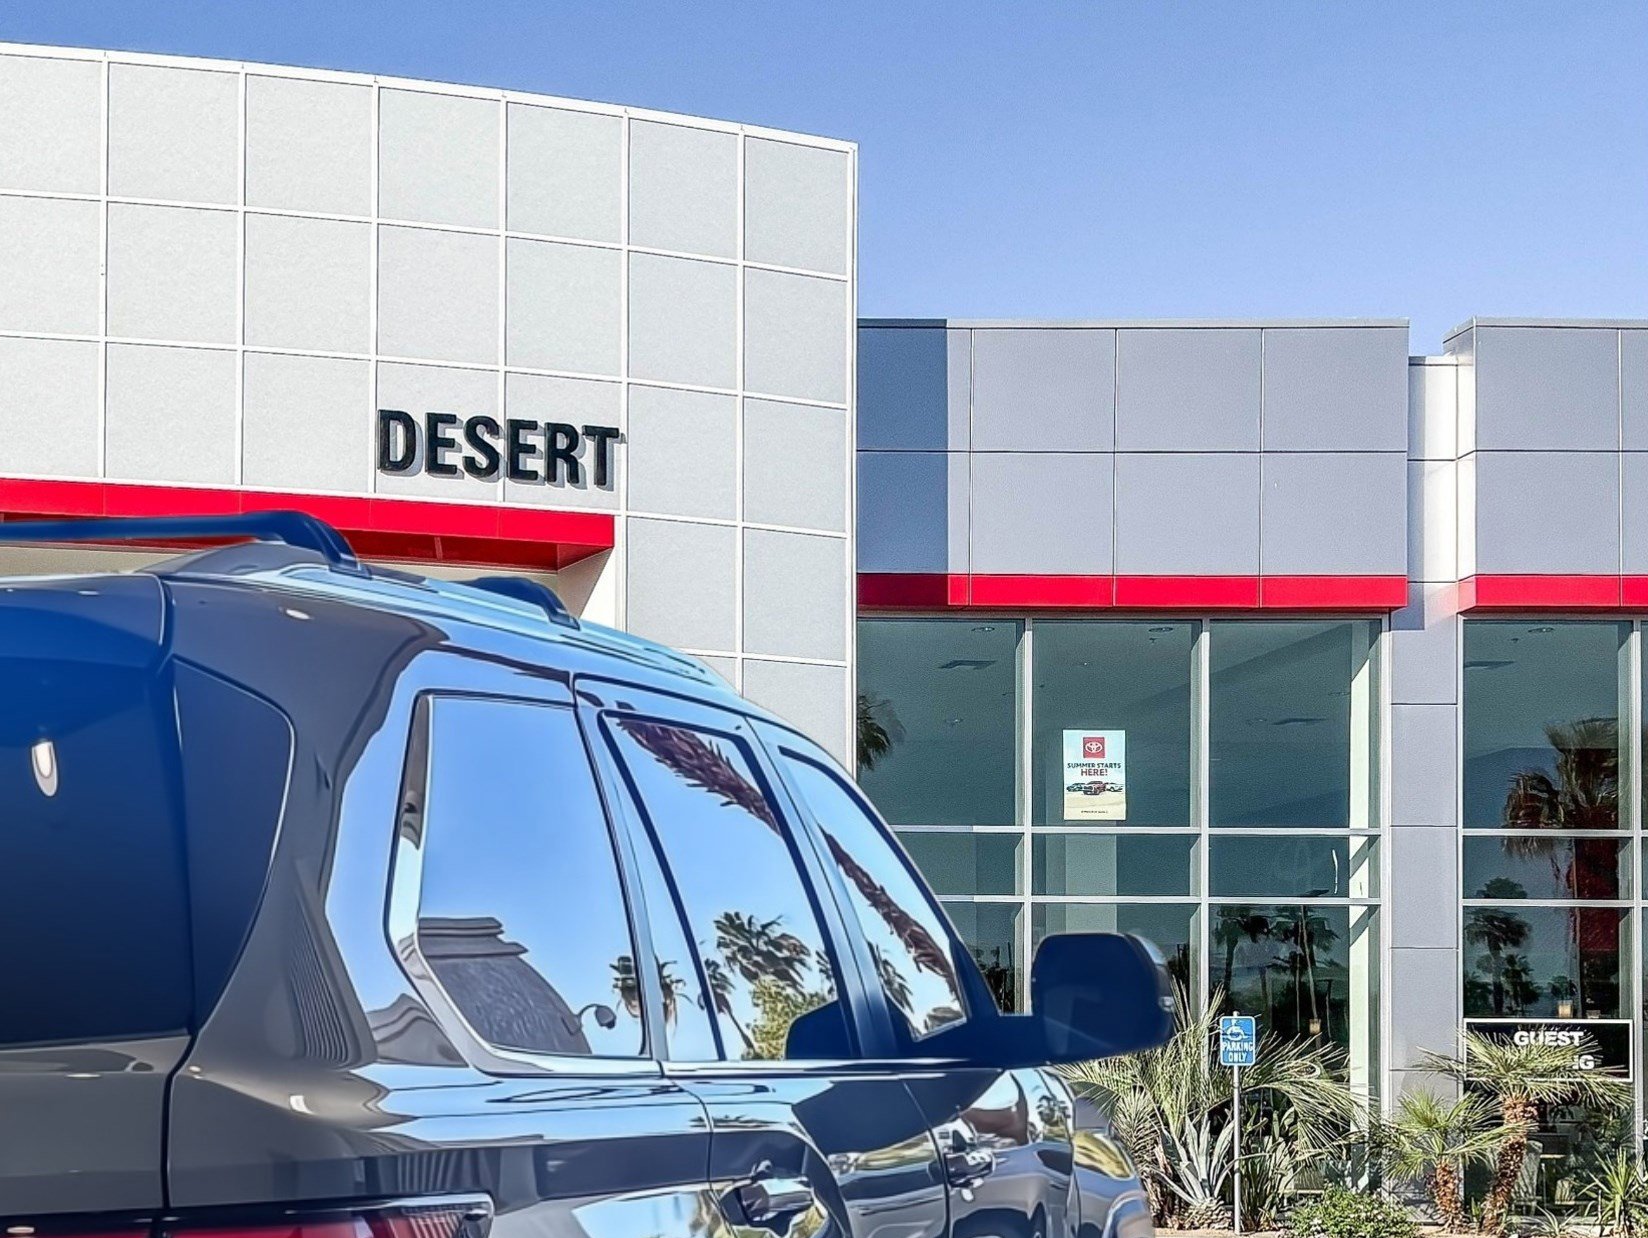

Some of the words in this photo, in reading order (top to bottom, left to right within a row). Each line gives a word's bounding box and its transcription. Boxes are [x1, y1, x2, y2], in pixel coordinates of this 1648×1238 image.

[376, 408, 621, 486] DESERT
[1080, 768, 1108, 777] HERE!
[1513, 1030, 1585, 1047] GUEST
[1222, 1040, 1253, 1052] PARKING
[1228, 1051, 1248, 1063] ONLY
